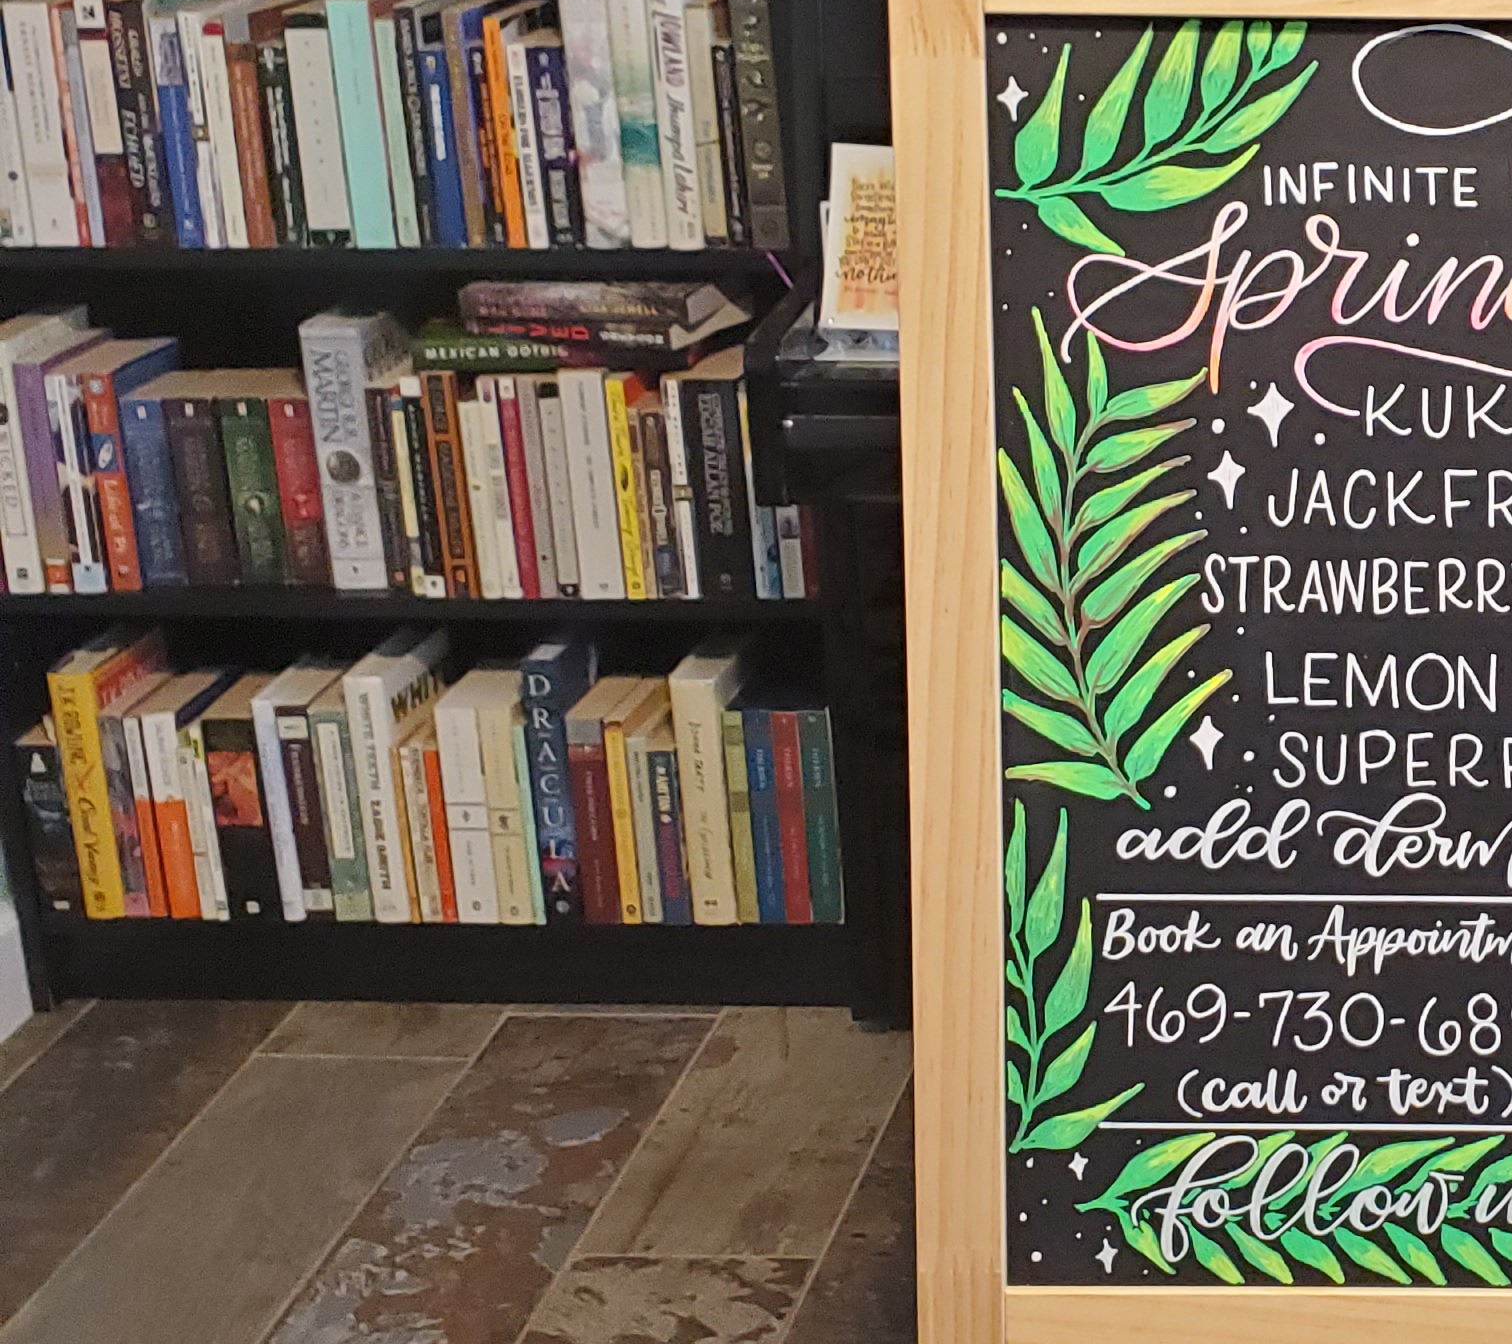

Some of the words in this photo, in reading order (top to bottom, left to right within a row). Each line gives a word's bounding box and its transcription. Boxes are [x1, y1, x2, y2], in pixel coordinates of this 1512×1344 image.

[1262, 161, 1478, 207] INFINITE
[424, 344, 501, 360] MEXICAN
[1264, 650, 1498, 714] LEMON
[528, 674, 576, 892] DRACULA
[1115, 796, 1312, 870] add
[1101, 907, 1222, 961] Book
[1235, 920, 1300, 961] an
[1176, 1066, 1309, 1119] (call
[1320, 1071, 1368, 1113] or
[1129, 1134, 1466, 1263] follow
